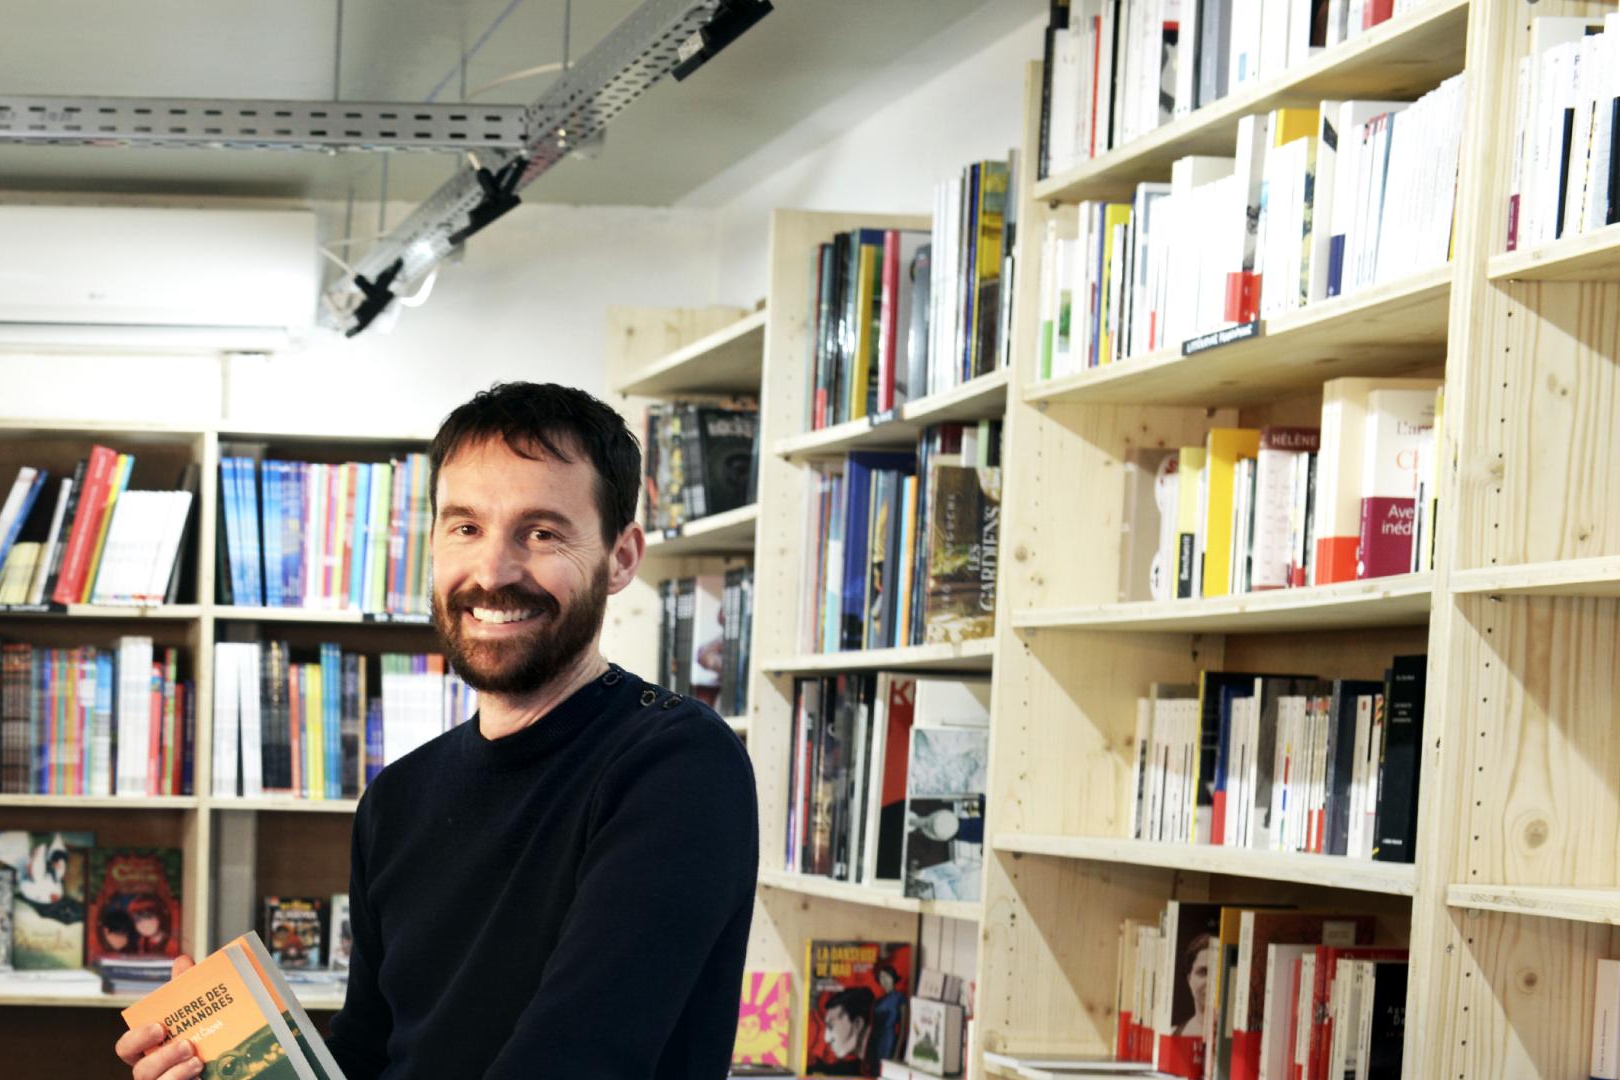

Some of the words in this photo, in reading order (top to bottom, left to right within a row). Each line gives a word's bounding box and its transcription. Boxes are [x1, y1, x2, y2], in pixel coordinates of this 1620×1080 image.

[1271, 431, 1318, 447] HÉLÈNE
[1387, 504, 1416, 518] Ave
[968, 543, 981, 571] LES
[980, 505, 1001, 612] GARDIENS
[164, 996, 207, 1027] GUERRE
[204, 983, 228, 1002] DES
